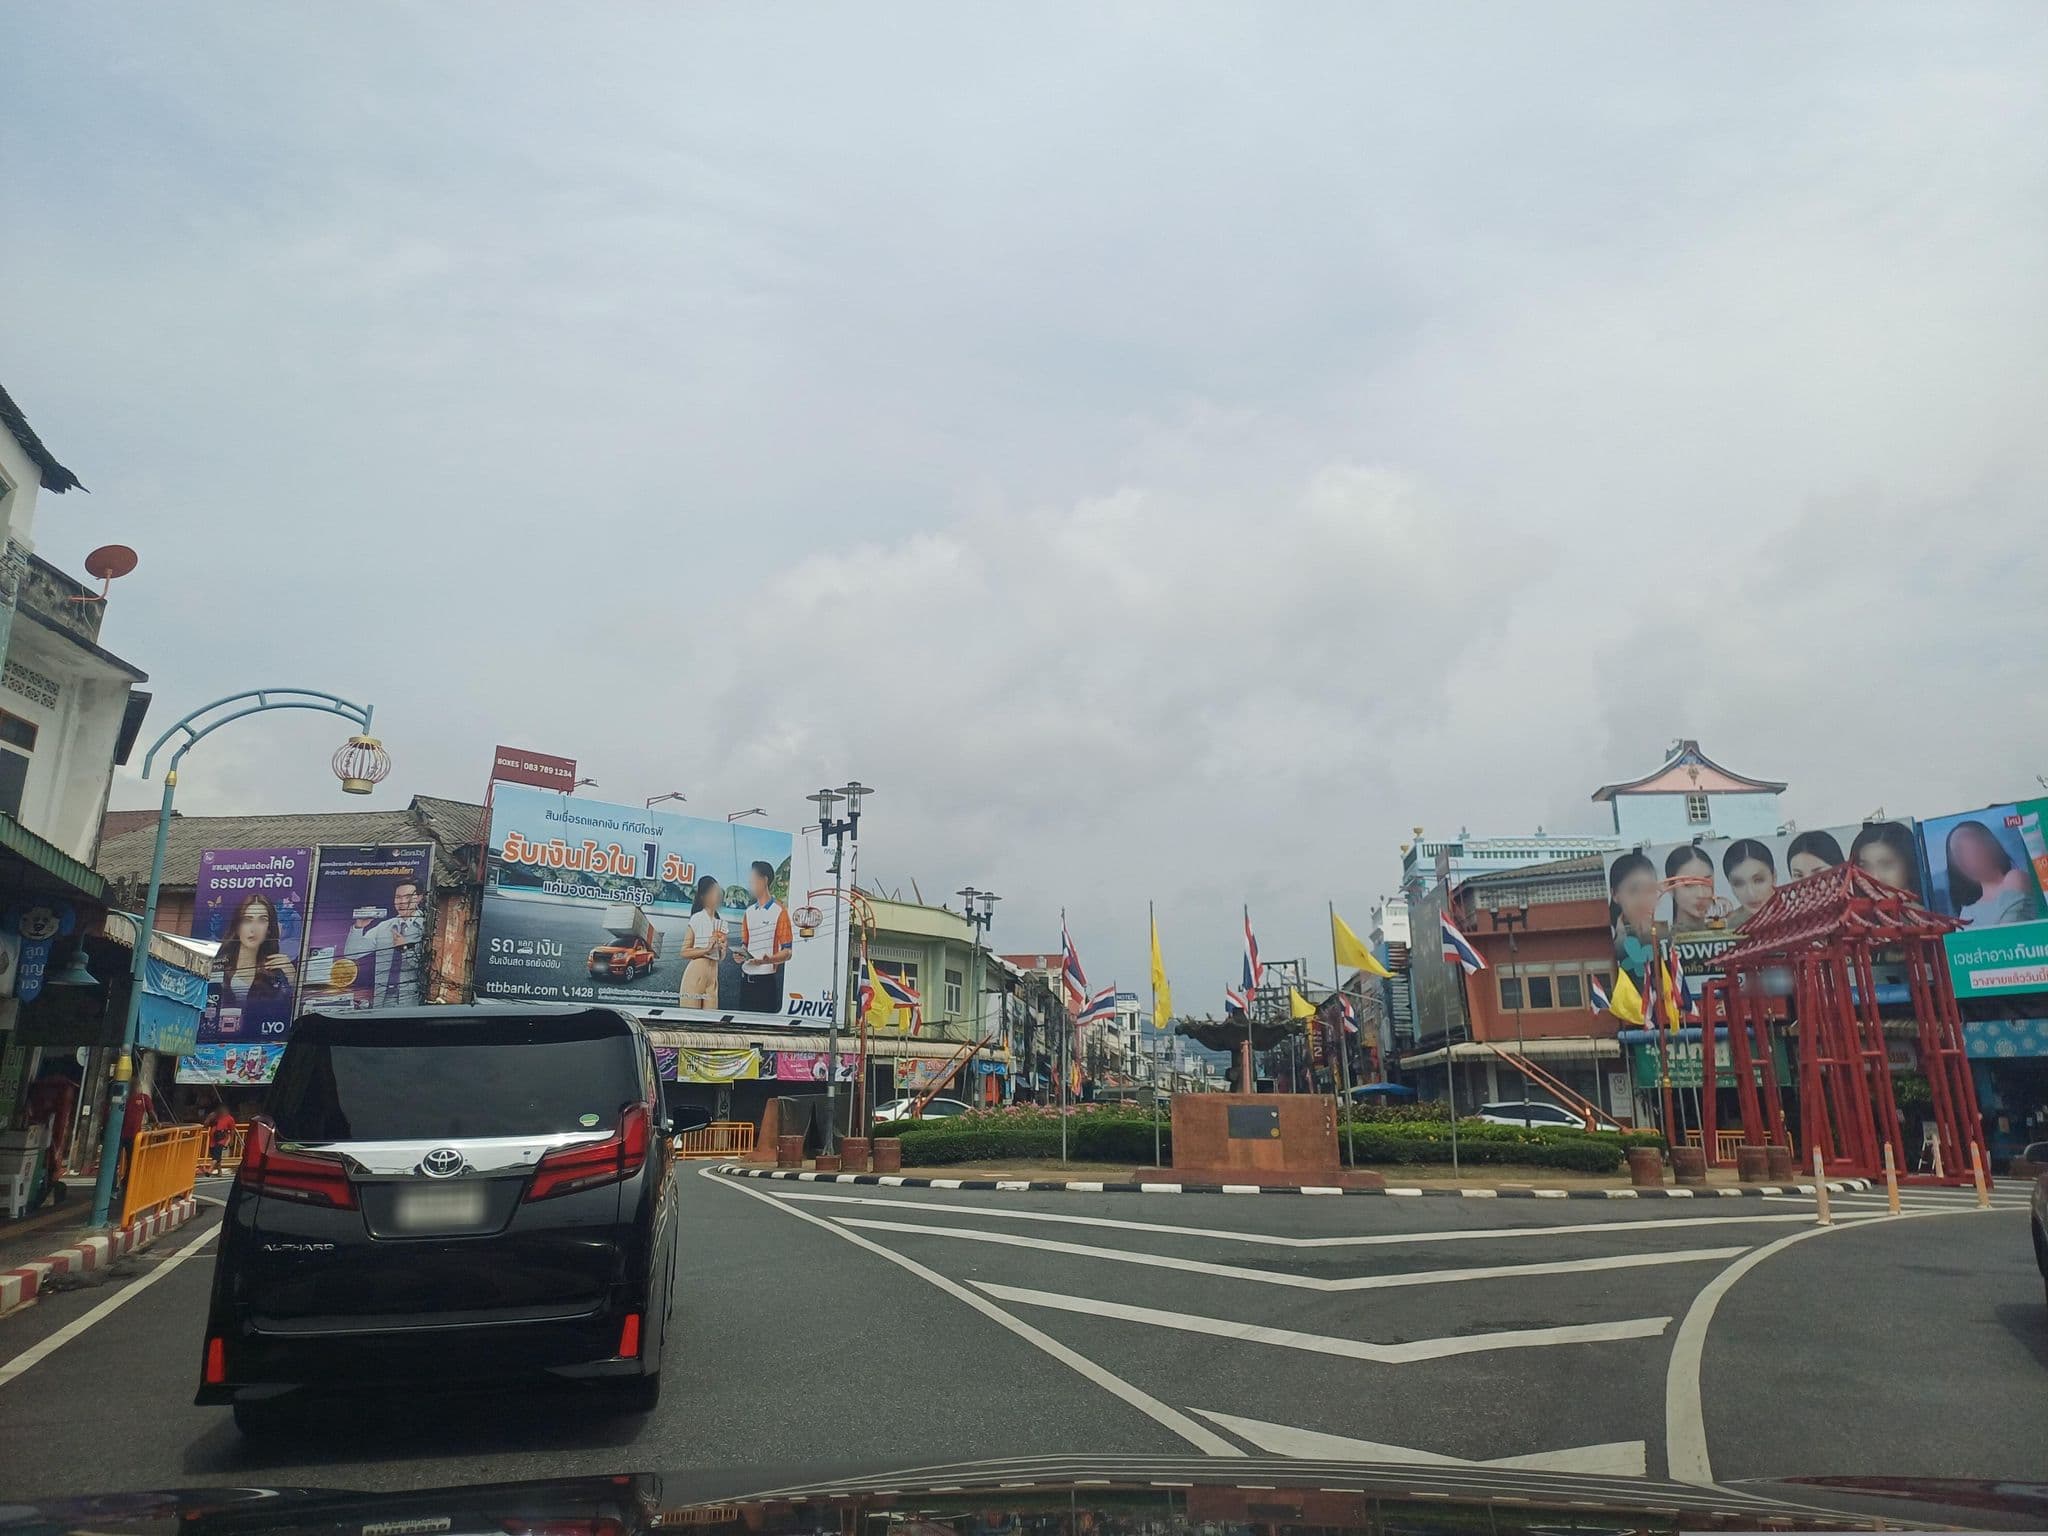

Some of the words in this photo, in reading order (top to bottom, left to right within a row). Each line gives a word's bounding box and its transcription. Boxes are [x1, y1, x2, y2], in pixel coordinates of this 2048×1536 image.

[497, 758, 520, 768] BOXES
[554, 768, 573, 778] 1234
[545, 810, 619, 830] สินเชื่อรถแลกเงิน
[502, 832, 636, 876] รับเงินไวใน
[643, 843, 658, 879] 1
[663, 853, 695, 885] วัน
[210, 873, 293, 889] ธรรมชาติจัด
[25, 946, 45, 960] ลูก
[490, 938, 514, 954] รถ
[536, 938, 563, 957] เงิน
[486, 981, 558, 997] ttbbank.com
[571, 986, 594, 998] 1428
[261, 1021, 285, 1034] LYO
[264, 1243, 335, 1252] ALPHARD
